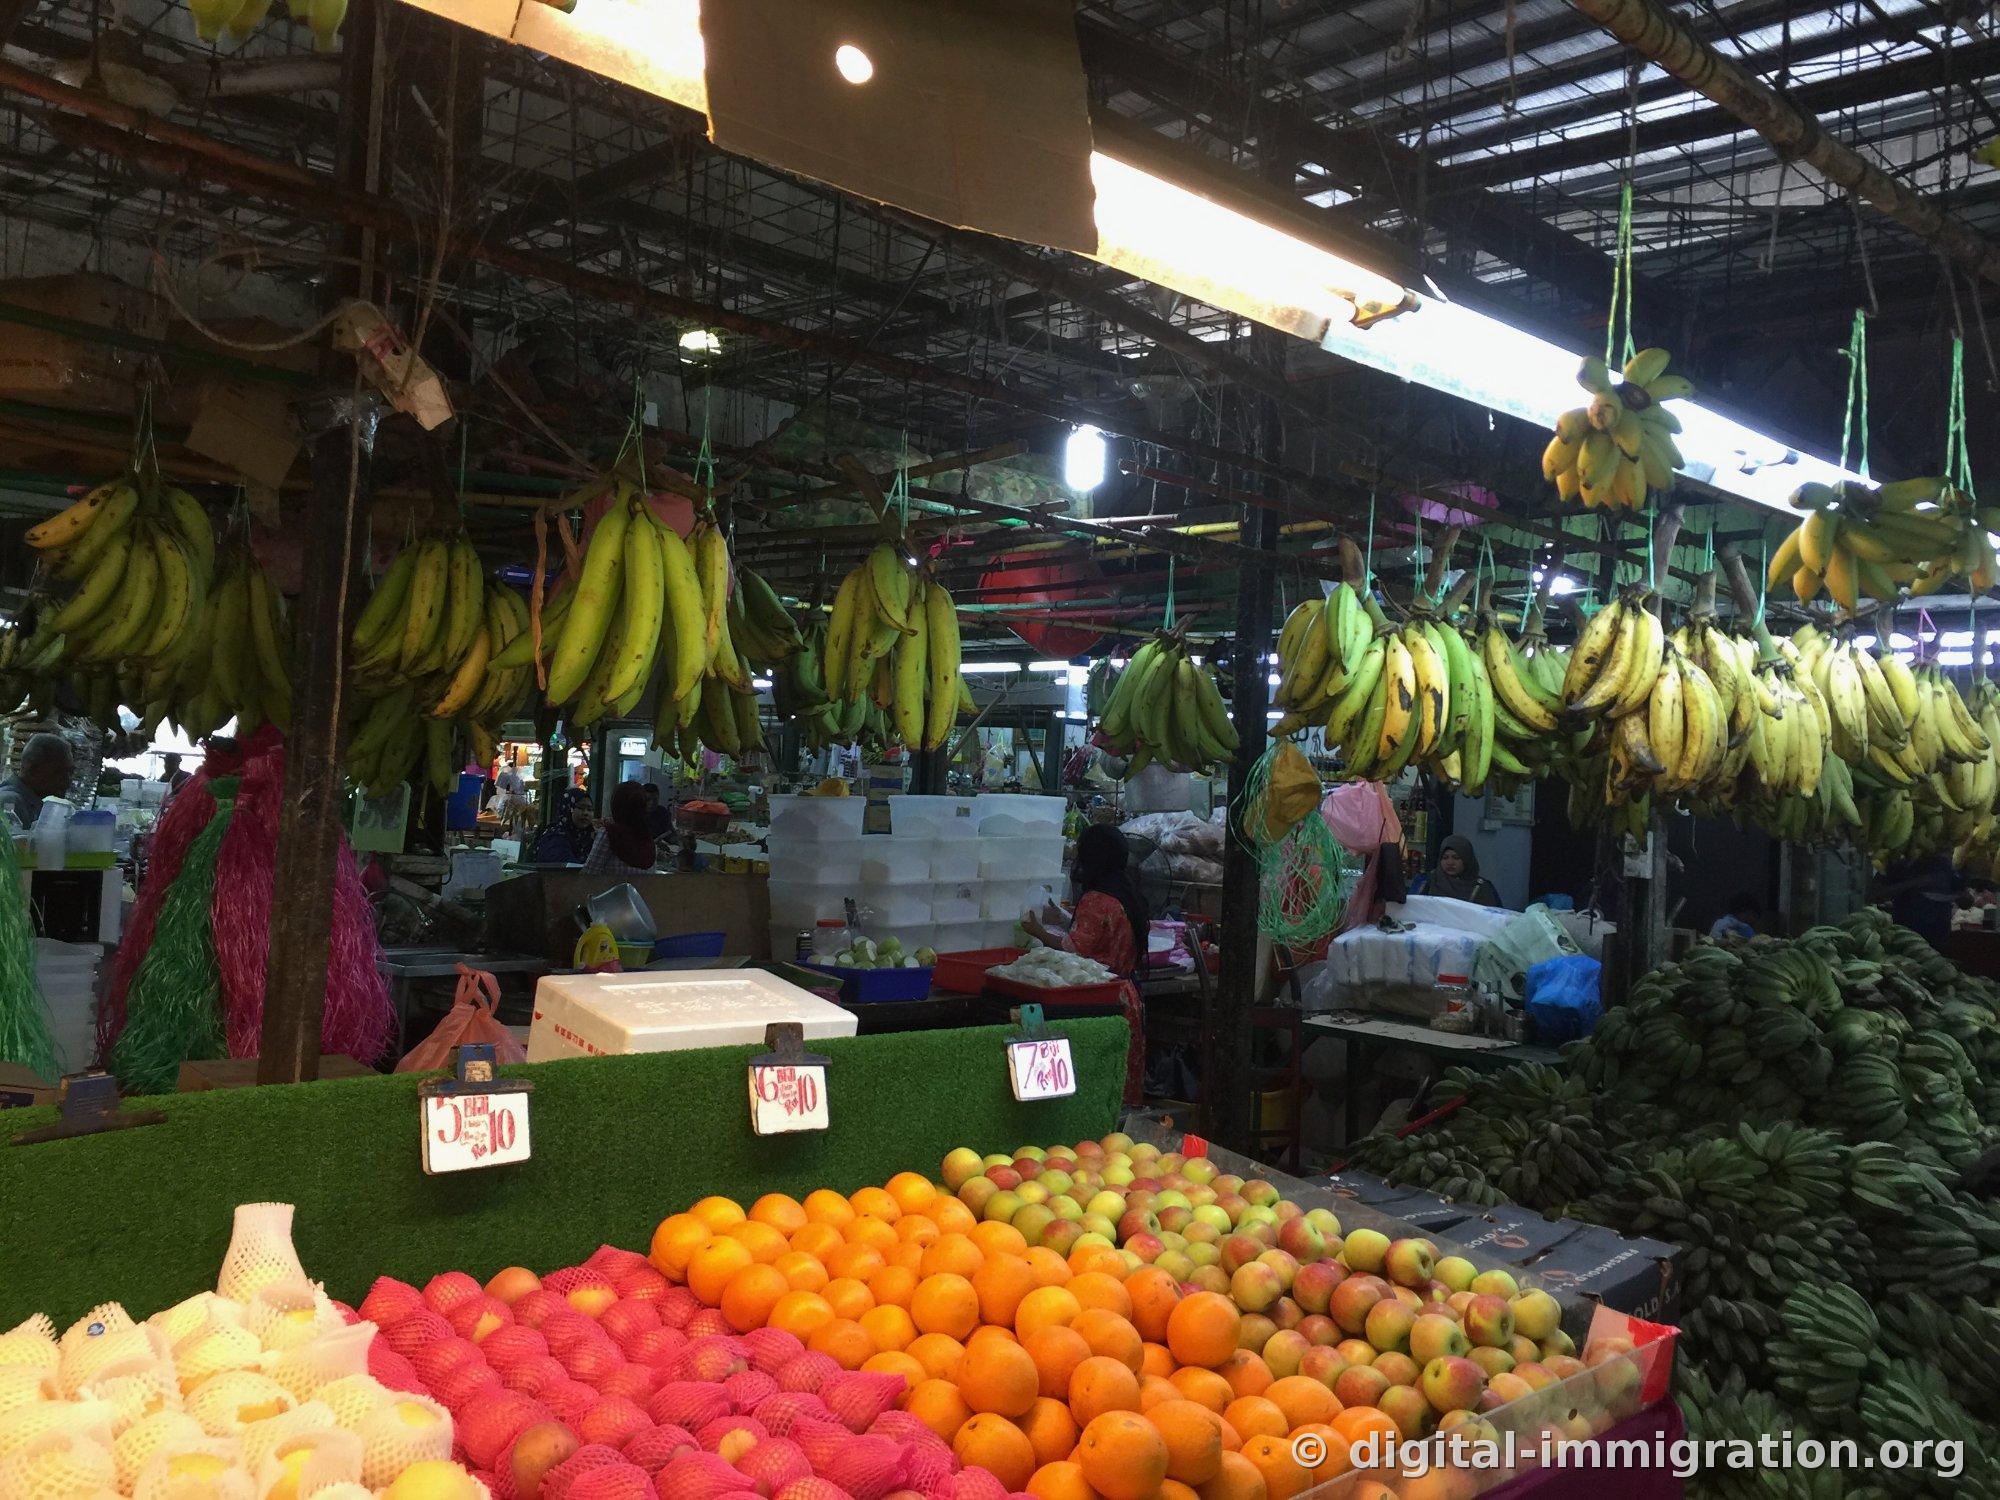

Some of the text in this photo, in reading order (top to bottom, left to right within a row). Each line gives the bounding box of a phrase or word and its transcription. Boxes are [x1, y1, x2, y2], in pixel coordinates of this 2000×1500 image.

[757, 1066, 779, 1102] 6
[1018, 1043, 1037, 1089] 7
[1050, 1057, 1068, 1092] 10
[798, 1074, 817, 1116] 10
[436, 1095, 462, 1143] 5
[488, 1108, 516, 1155] 10
